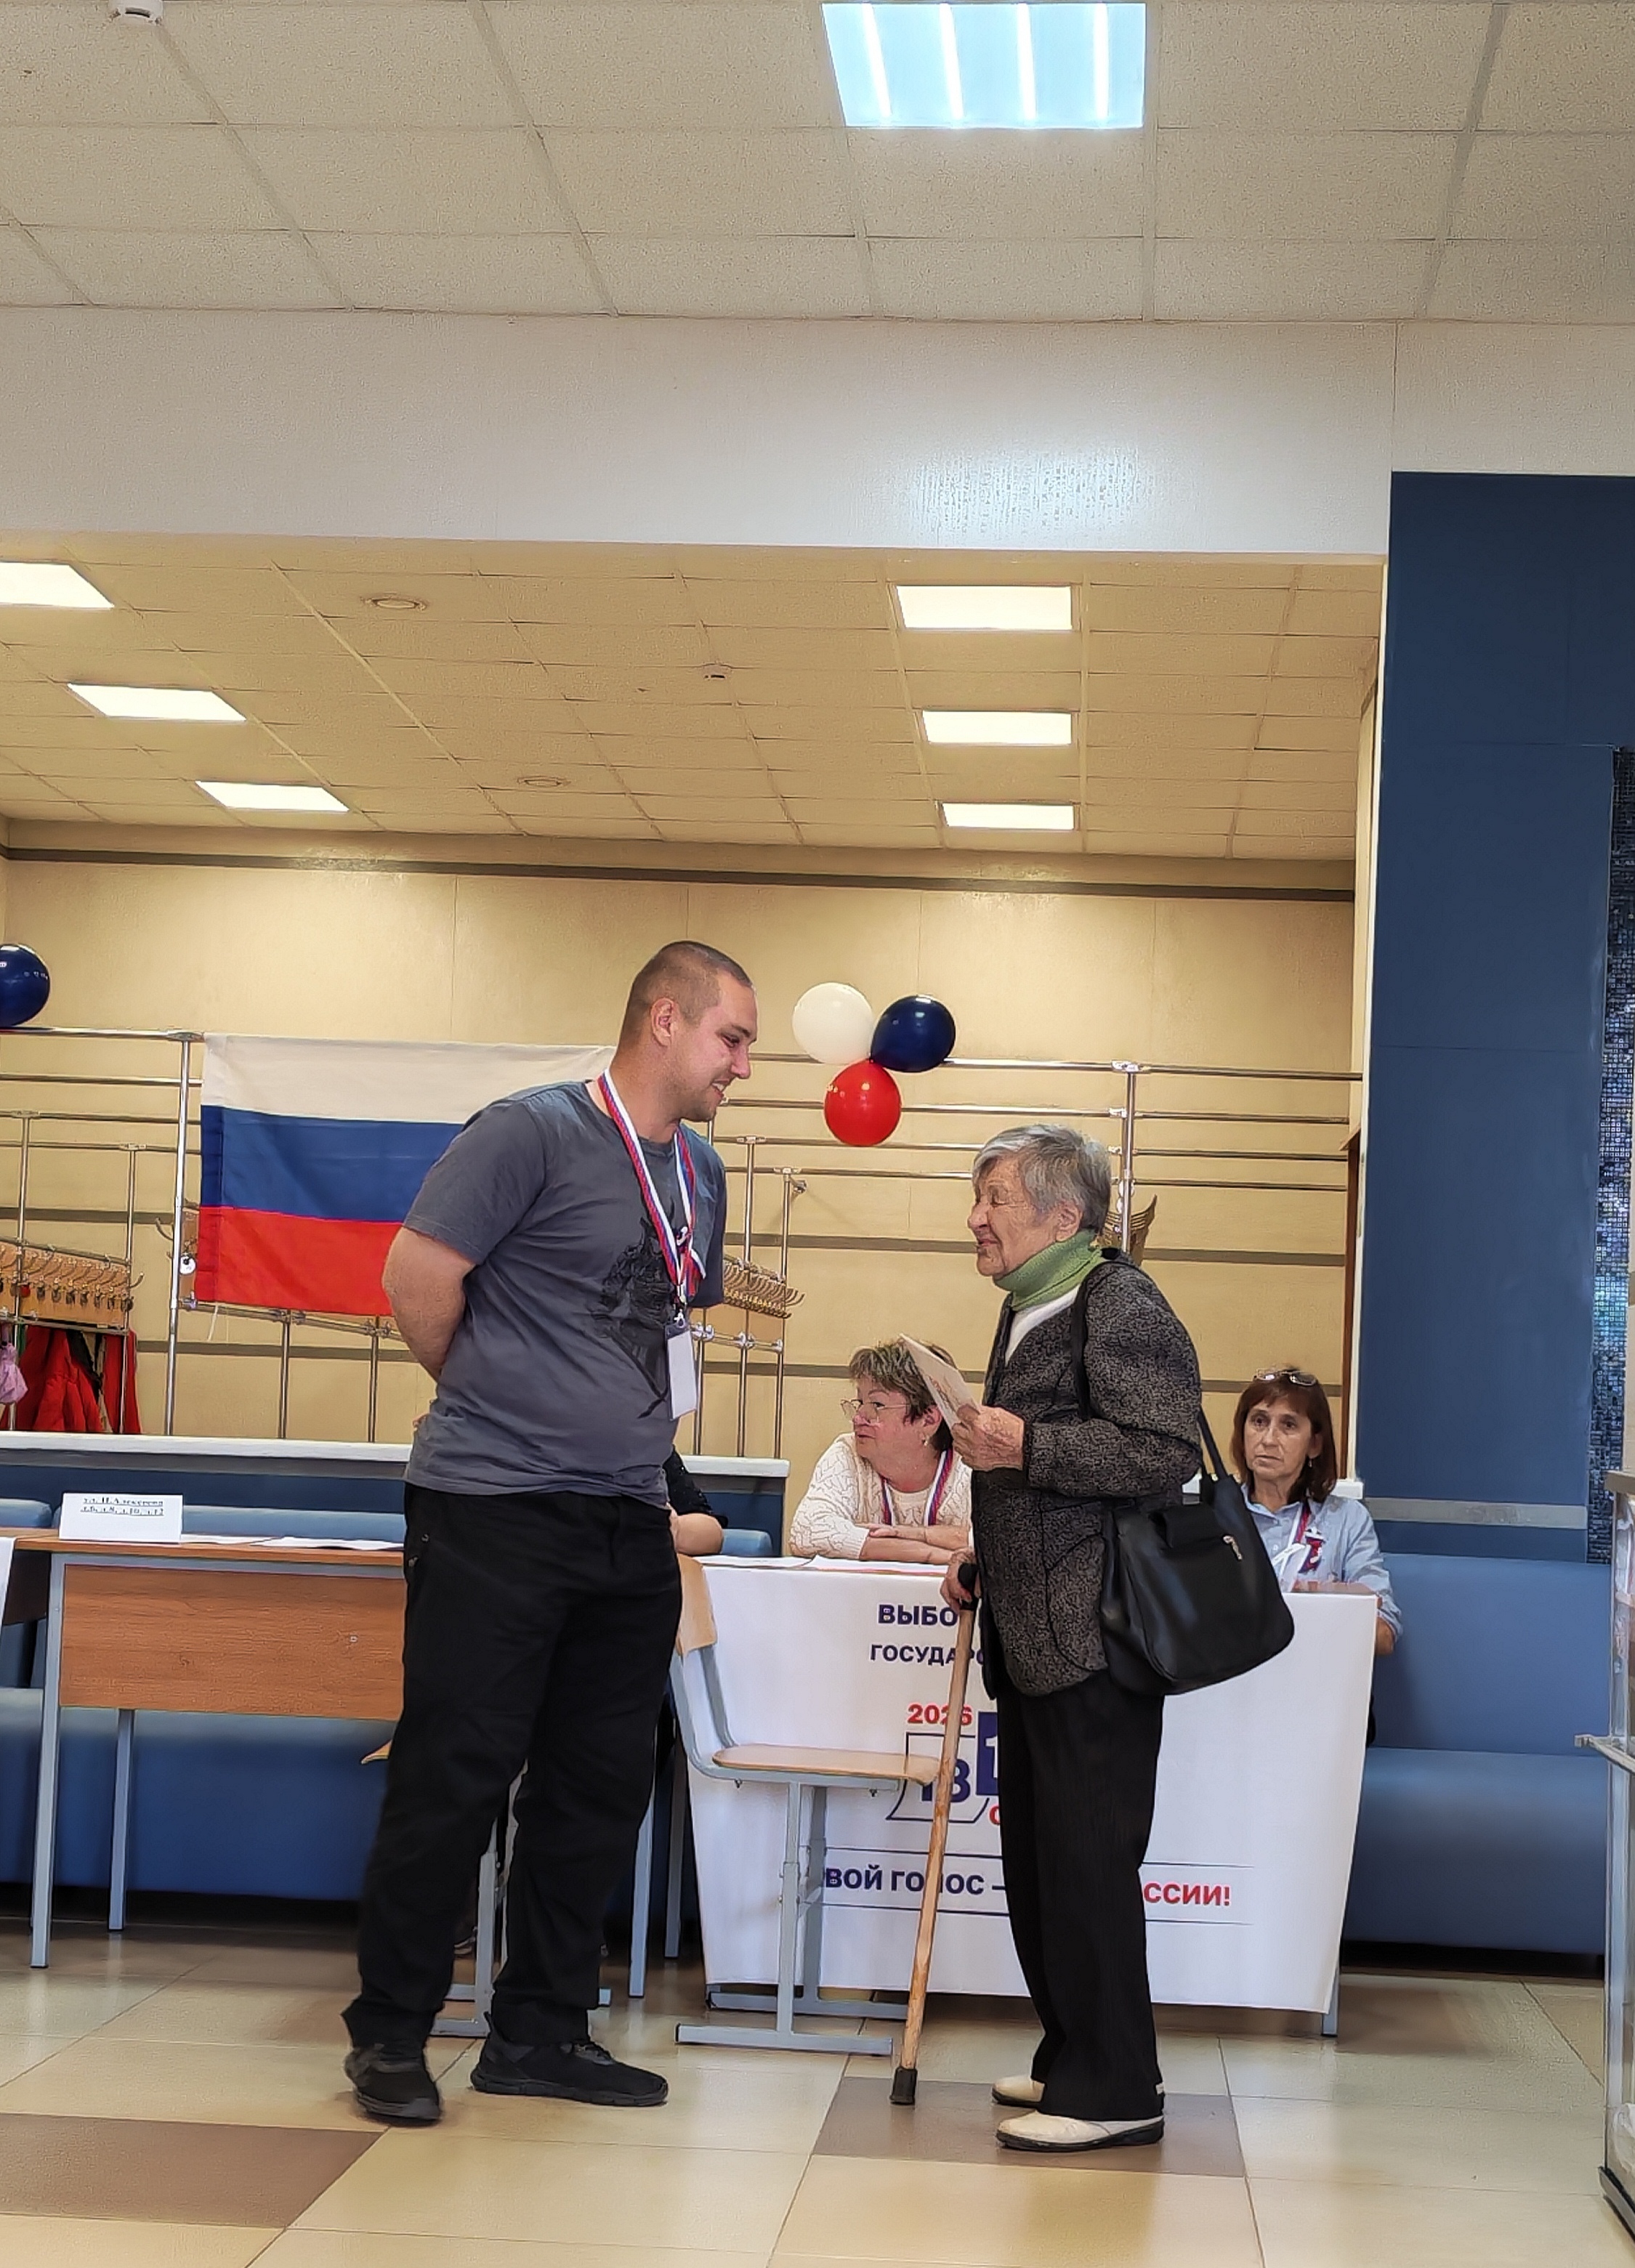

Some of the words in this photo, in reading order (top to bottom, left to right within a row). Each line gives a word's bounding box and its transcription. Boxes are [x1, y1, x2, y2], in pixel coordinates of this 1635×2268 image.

[878, 1603, 958, 1627] ВЫБО
[825, 1863, 883, 1891] ВОЙ
[890, 1869, 985, 1895] ГООС
[1143, 1882, 1230, 1906] ССИИ!
